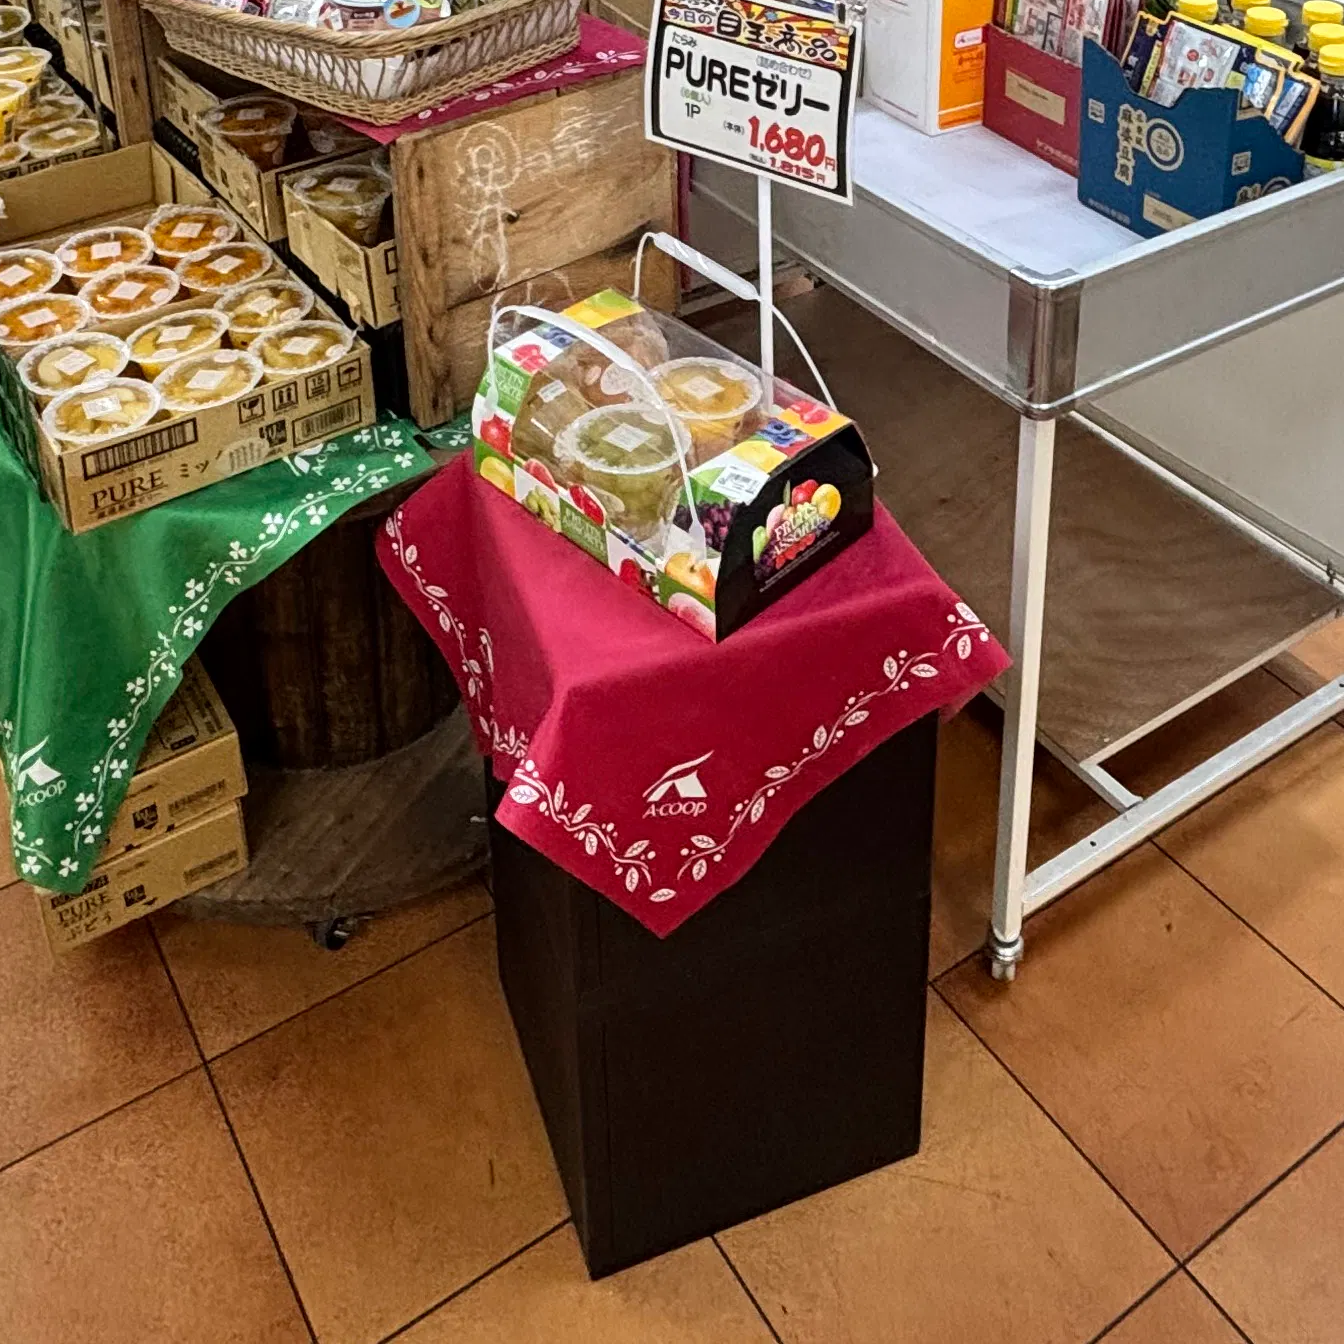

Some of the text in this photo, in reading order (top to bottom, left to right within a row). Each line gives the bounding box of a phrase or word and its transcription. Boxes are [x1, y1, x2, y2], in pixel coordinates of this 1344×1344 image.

[671, 31, 698, 48] たらみ
[665, 46, 831, 117] PUREゼリー
[684, 102, 702, 119] 1P
[90, 469, 168, 510] PURE
[641, 801, 708, 819] A-COOP
